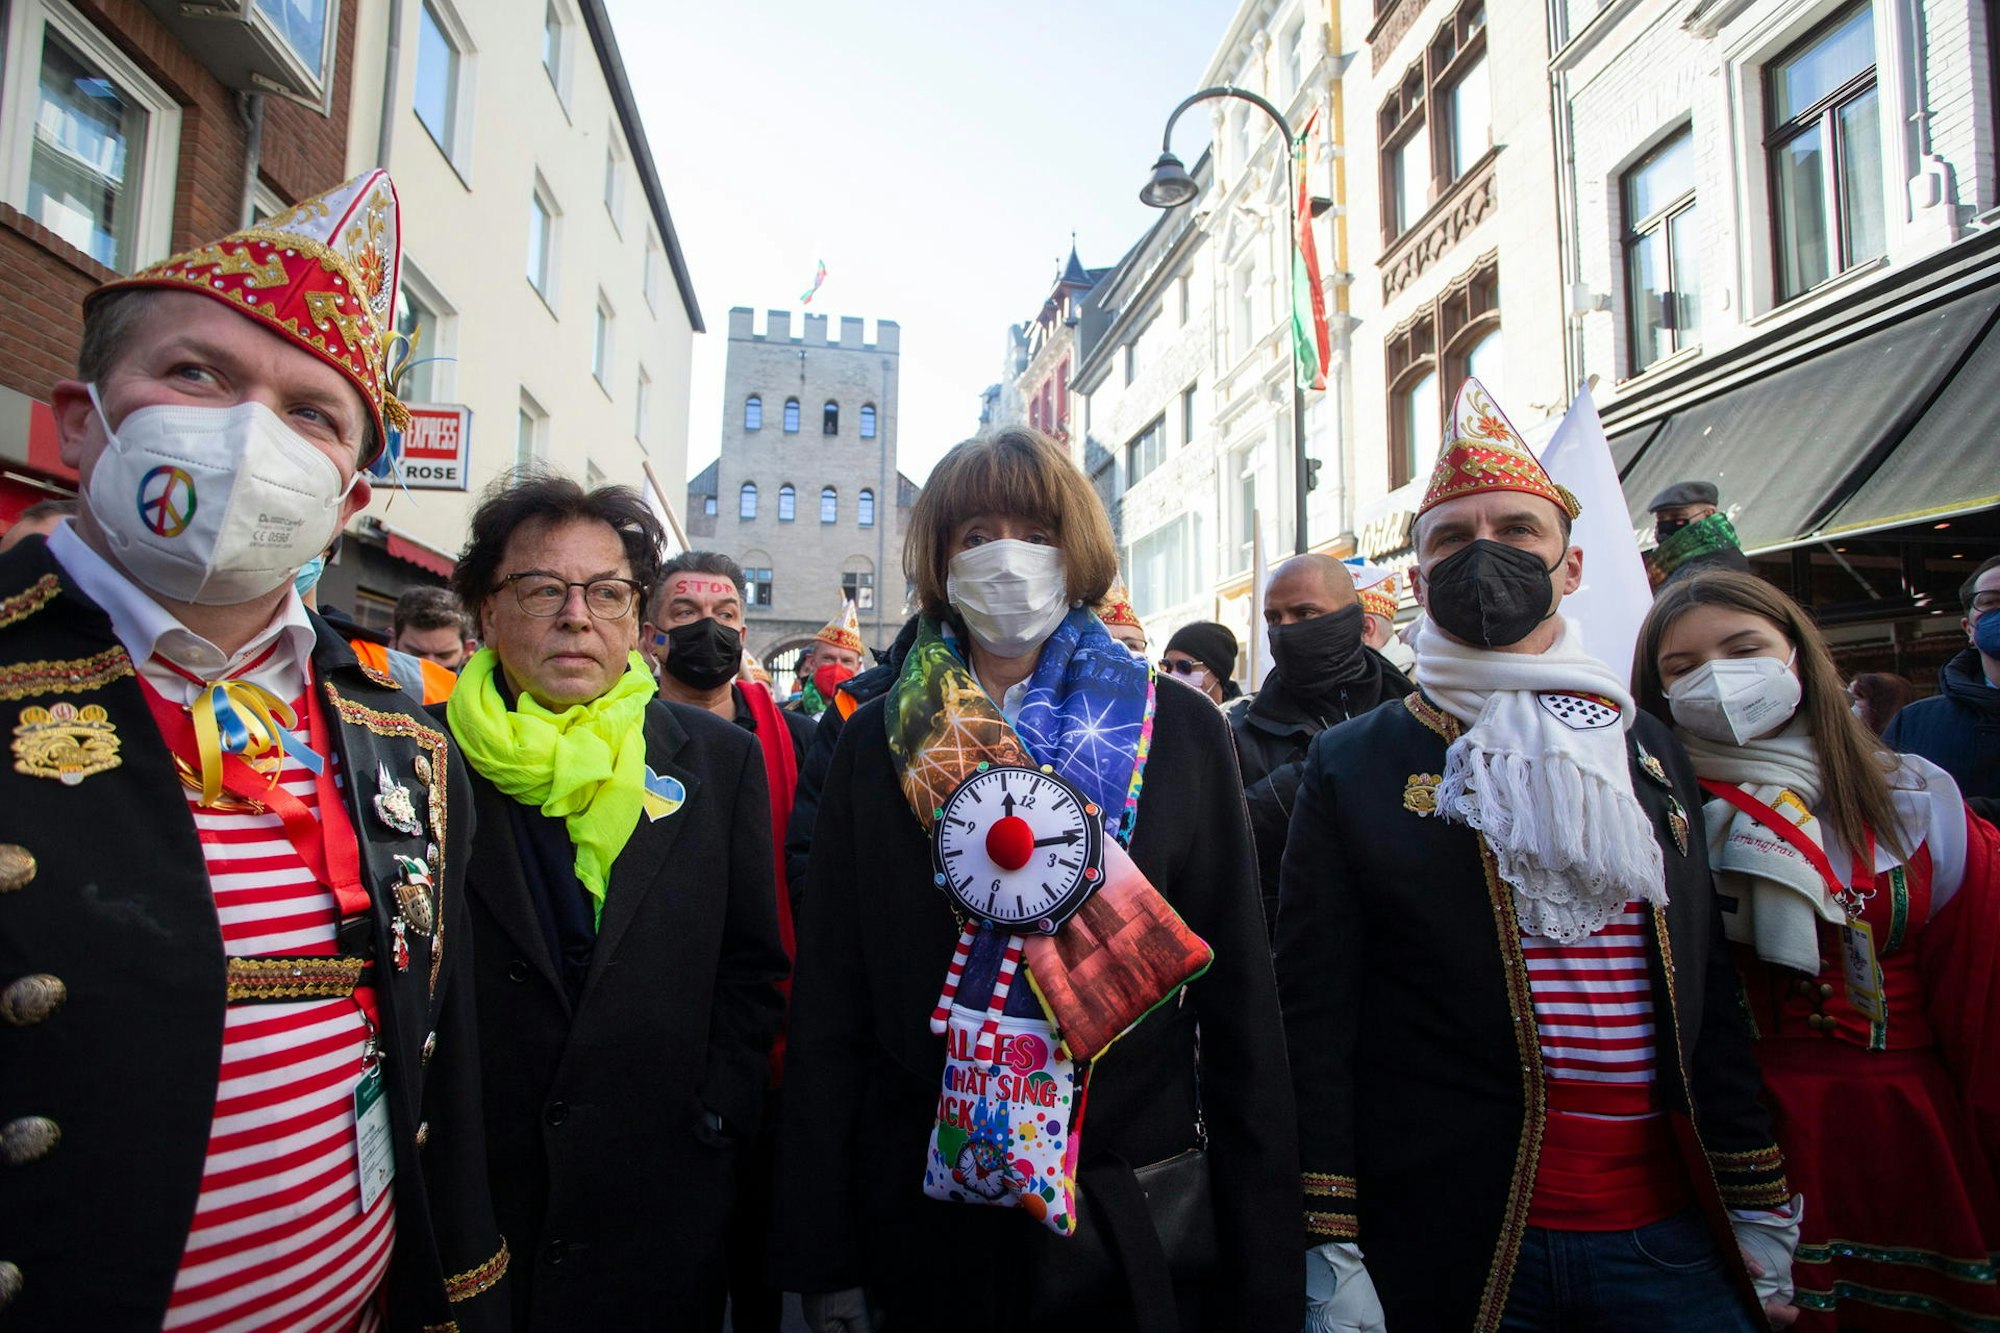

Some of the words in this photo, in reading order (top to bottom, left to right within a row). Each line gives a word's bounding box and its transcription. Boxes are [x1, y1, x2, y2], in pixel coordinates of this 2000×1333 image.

[406, 416, 458, 450] EXPRESS
[406, 466, 457, 480] ROSE
[675, 580, 734, 595] STOP
[1019, 794, 1037, 810] 12
[966, 821, 976, 835] 9
[1047, 853, 1058, 868] 3
[991, 879, 1001, 892] 6
[946, 1027, 1035, 1070] ALES
[952, 1066, 992, 1096] HÄT
[995, 1074, 1058, 1109] SING
[938, 1092, 975, 1132] ICK
